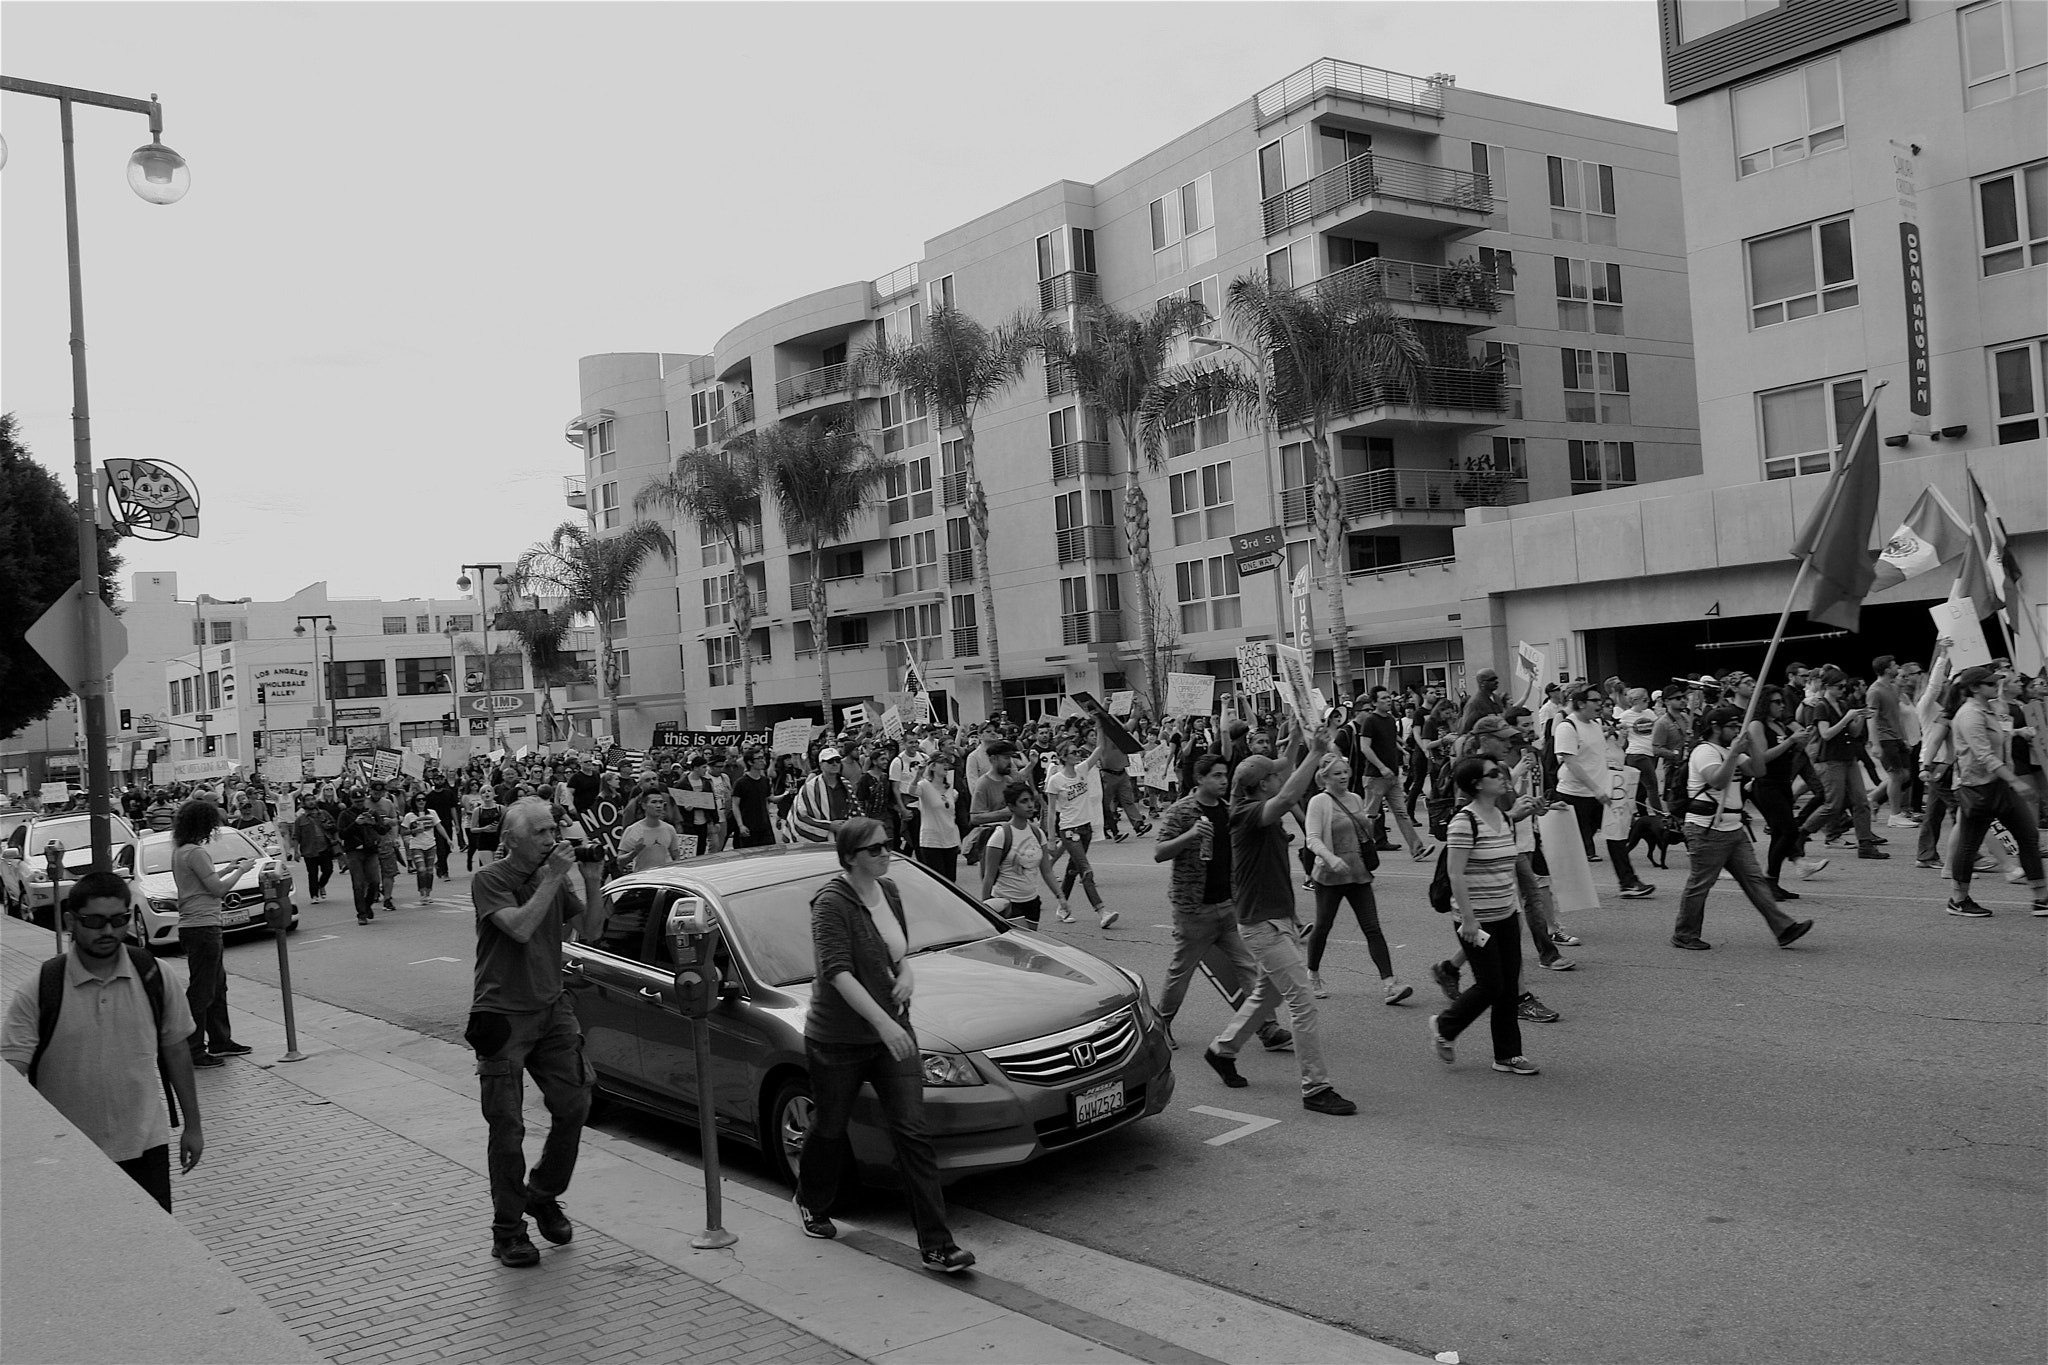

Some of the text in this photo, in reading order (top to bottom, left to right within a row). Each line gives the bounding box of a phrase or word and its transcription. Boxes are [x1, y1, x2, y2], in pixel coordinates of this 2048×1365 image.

[1907, 233, 1927, 403] 213.625.9200
[1240, 534, 1276, 550] 3rd St
[1242, 558, 1273, 571] ONE WAY
[1239, 643, 1262, 656] MAKE
[1237, 654, 1268, 668] RACISTS
[254, 668, 309, 680] LOS ANGELES
[1242, 665, 1270, 680] AFRAID
[258, 680, 306, 689] WHOLESALE
[1244, 679, 1273, 694] AGAIN
[664, 732, 690, 746] this
[694, 732, 706, 746] is
[710, 734, 741, 748] very
[744, 731, 769, 745] bad
[580, 801, 618, 832] NO
